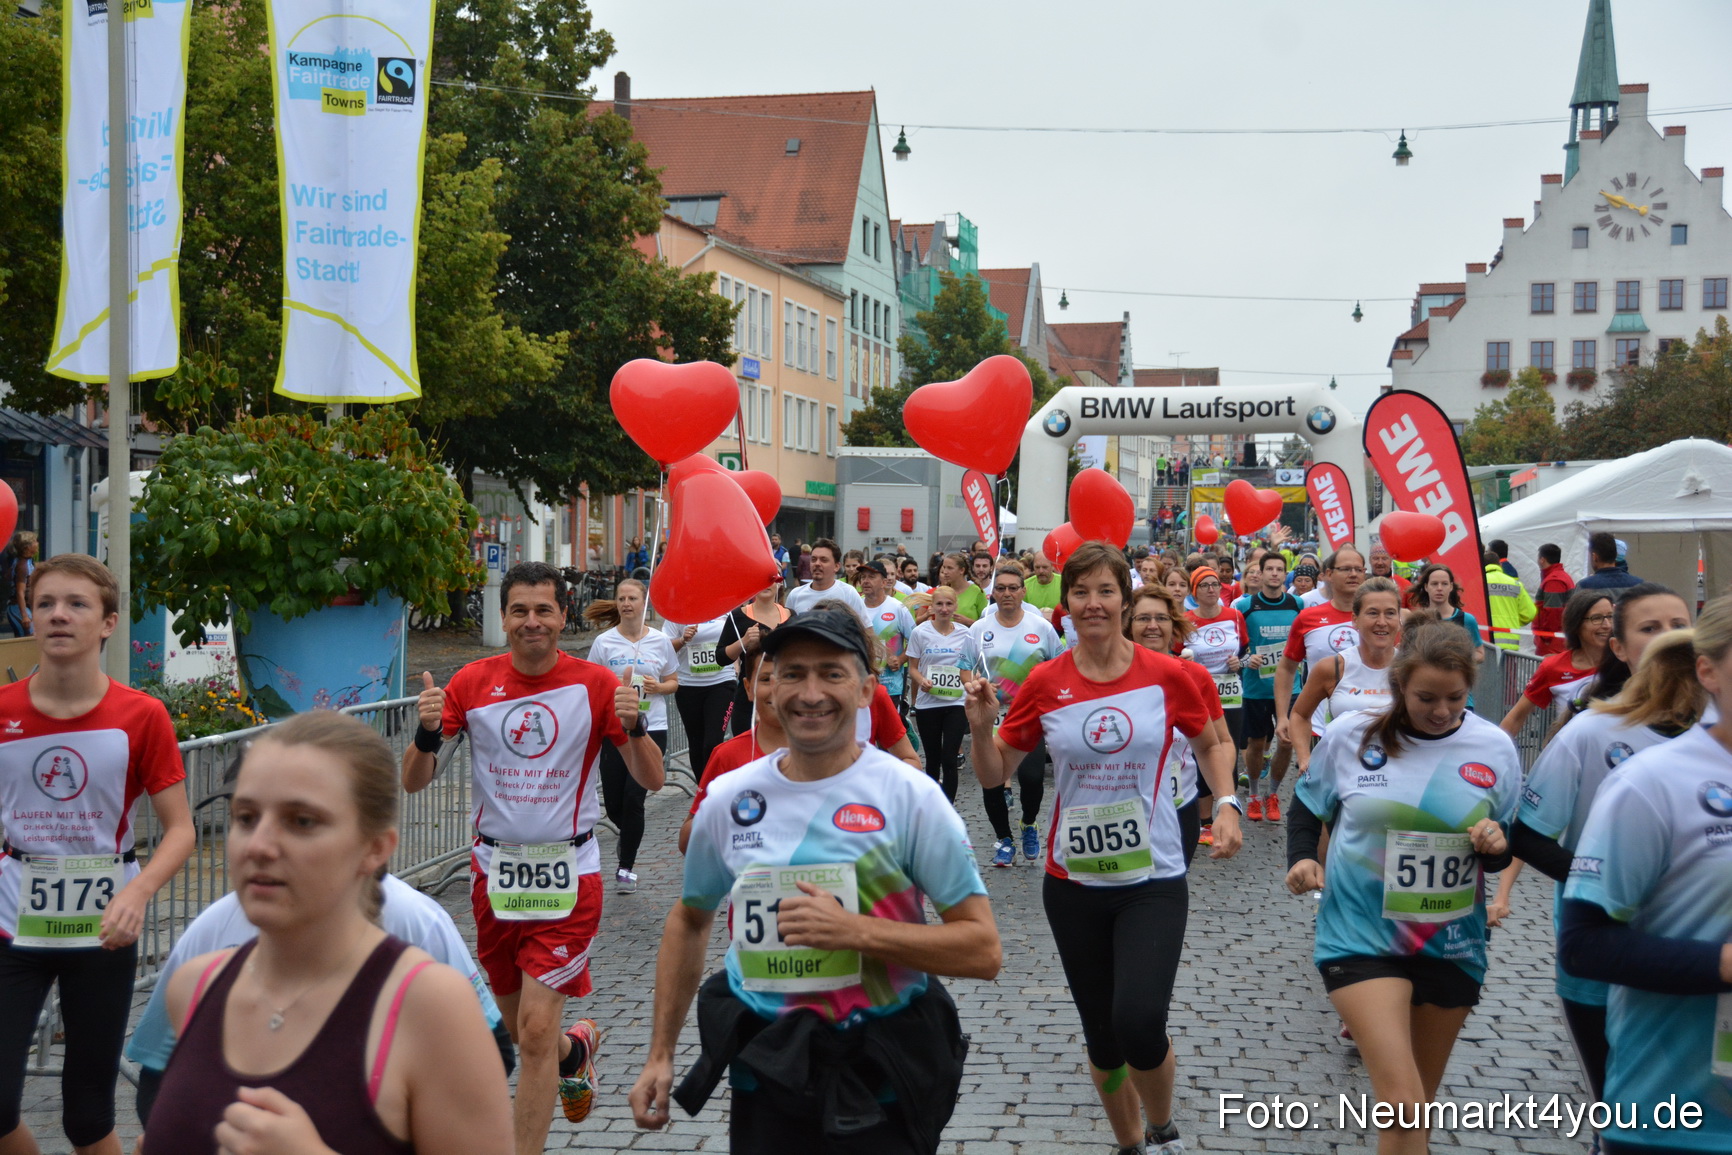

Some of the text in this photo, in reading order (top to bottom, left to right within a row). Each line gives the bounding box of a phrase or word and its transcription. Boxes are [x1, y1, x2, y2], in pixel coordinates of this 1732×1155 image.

[289, 53, 362, 73] Kampagne
[290, 66, 370, 89] Fairtrade
[323, 93, 364, 109] Towns
[378, 95, 413, 103] FAIRTRADE
[291, 184, 387, 212] Wir sind
[296, 220, 406, 248] Fairtrade-
[296, 257, 360, 283] Stadt!
[1080, 396, 1296, 423] BMW Laufsport
[490, 548, 497, 560] P
[692, 650, 716, 664] 505
[931, 673, 961, 688] 5023
[937, 688, 952, 696] Maria
[1216, 681, 1239, 696] 055
[722, 701, 735, 732] adidas
[1358, 774, 1388, 783] PARTL
[14, 810, 52, 820] LAUFEN
[57, 811, 75, 819] MIT
[1093, 802, 1135, 817] BOCK
[840, 810, 881, 826] Hervis
[732, 831, 763, 844] PARTL
[1069, 819, 1141, 854] 5053
[64, 857, 115, 870] BOCK
[1098, 860, 1118, 872] Eva
[1397, 853, 1477, 888] 5182
[499, 861, 571, 889] 5059
[780, 868, 843, 886] BOCK
[30, 876, 115, 911] 5173
[504, 896, 560, 909] Johannes
[1420, 897, 1452, 910] Anne
[45, 920, 93, 934] Tilman
[767, 956, 822, 978] Holger
